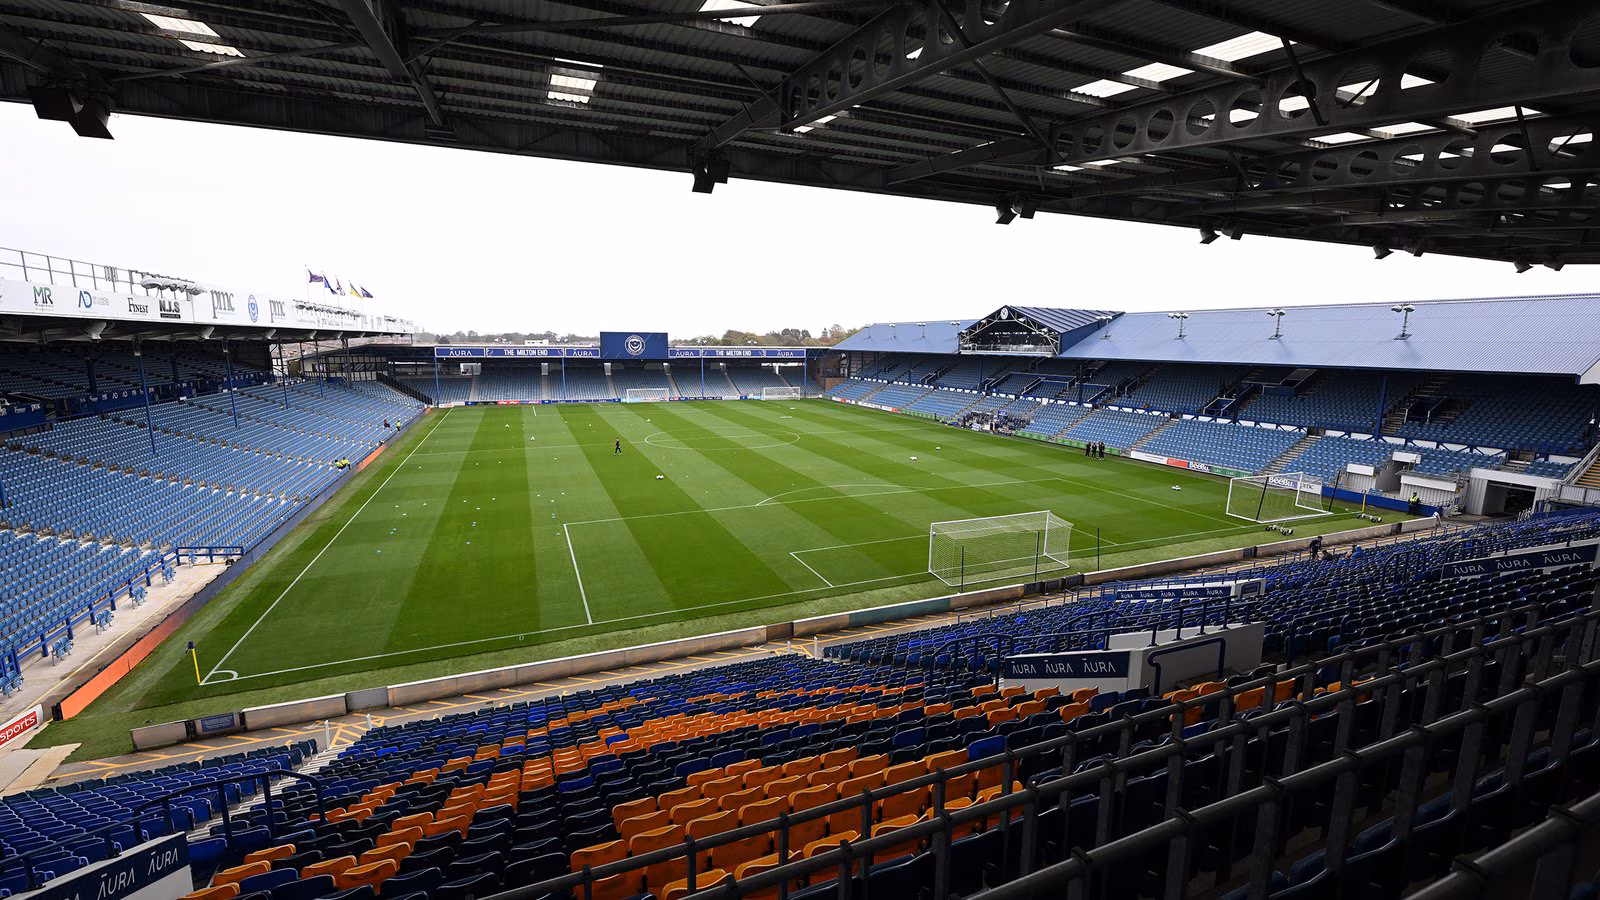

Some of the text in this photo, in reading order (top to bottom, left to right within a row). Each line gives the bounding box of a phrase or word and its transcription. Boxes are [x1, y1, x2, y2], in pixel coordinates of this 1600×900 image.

[33, 286, 53, 304] MR
[210, 289, 236, 319] pmc
[269, 299, 286, 323] pmc
[0, 715, 36, 741] sports
